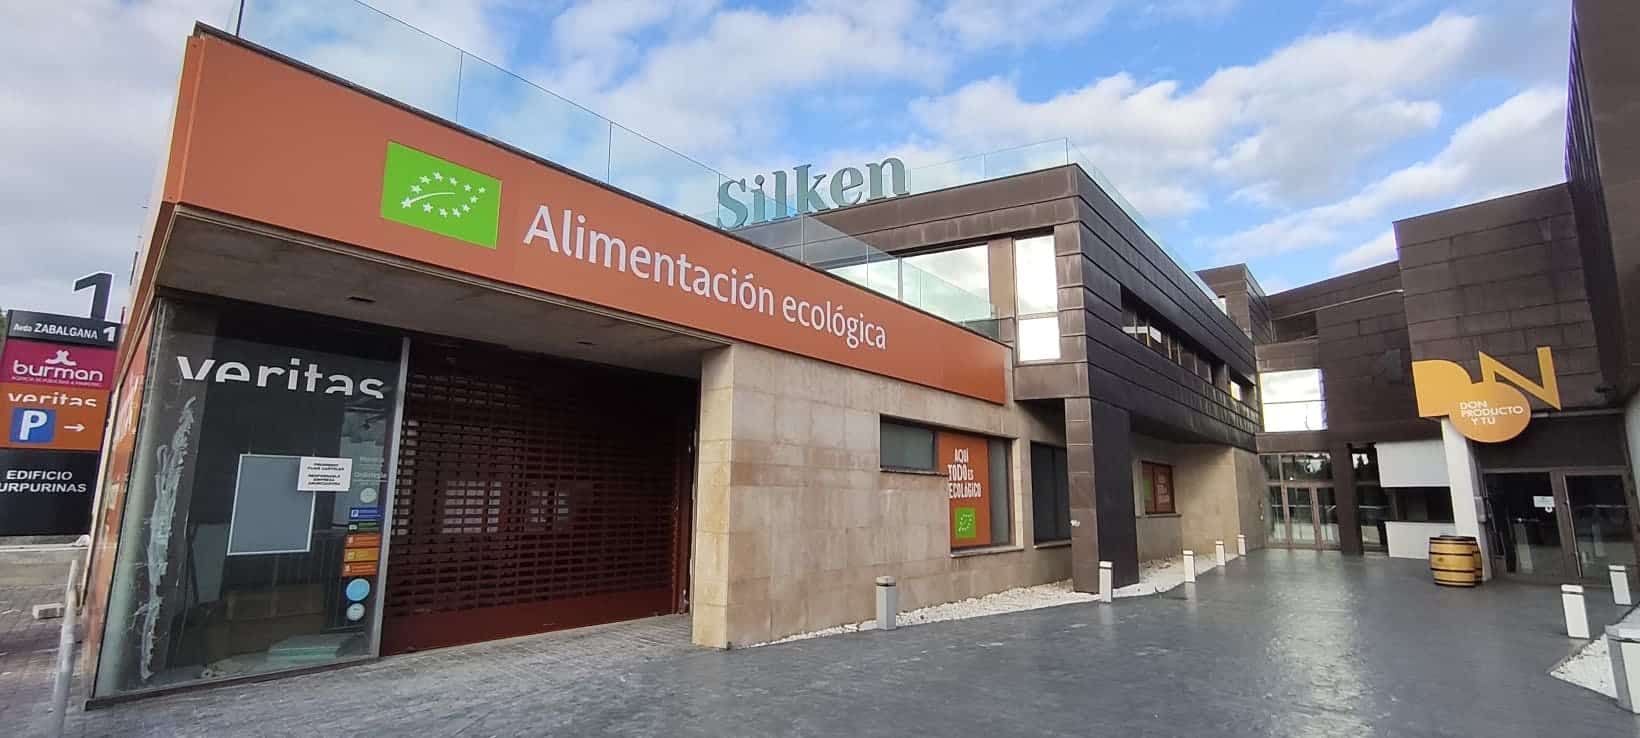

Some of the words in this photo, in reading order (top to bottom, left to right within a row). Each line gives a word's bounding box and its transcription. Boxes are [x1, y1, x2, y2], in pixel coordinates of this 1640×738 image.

[718, 157, 910, 230] Silken
[523, 205, 774, 316] Alimentación
[782, 295, 887, 349] ecológica
[74, 272, 113, 319] 1
[34, 322, 98, 339] ZABALGANA
[103, 326, 117, 342] 1
[13, 359, 104, 381] burman
[176, 355, 384, 399] veritas
[8, 392, 97, 407] veritas
[1460, 400, 1488, 410] DON
[1461, 406, 1524, 418] PRODUCTO
[1471, 416, 1479, 425] Y
[19, 410, 48, 441] P
[6, 470, 73, 480] EDIFICIO
[947, 463, 968, 481] TODO
